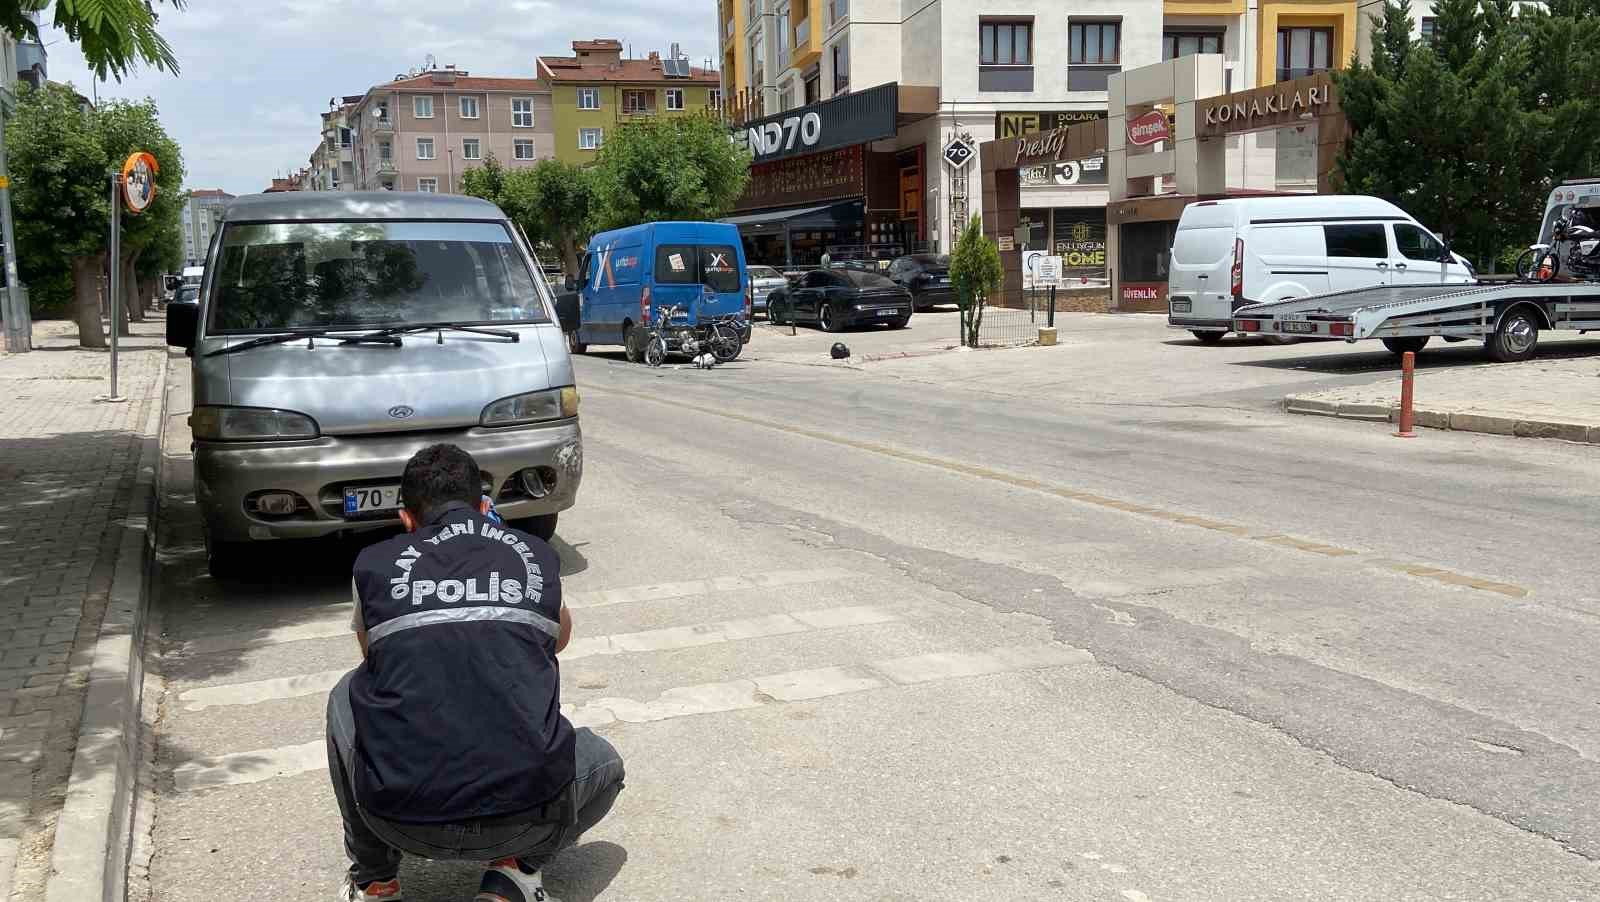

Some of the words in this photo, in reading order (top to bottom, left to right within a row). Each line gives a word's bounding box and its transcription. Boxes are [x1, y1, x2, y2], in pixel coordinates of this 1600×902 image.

[1057, 113, 1100, 121] DOLARA
[1204, 84, 1329, 125] KONAKLARI
[948, 148, 968, 158] 70
[357, 489, 382, 508] 70
[390, 545, 422, 600] OLAY
[411, 571, 523, 605] POLİS
